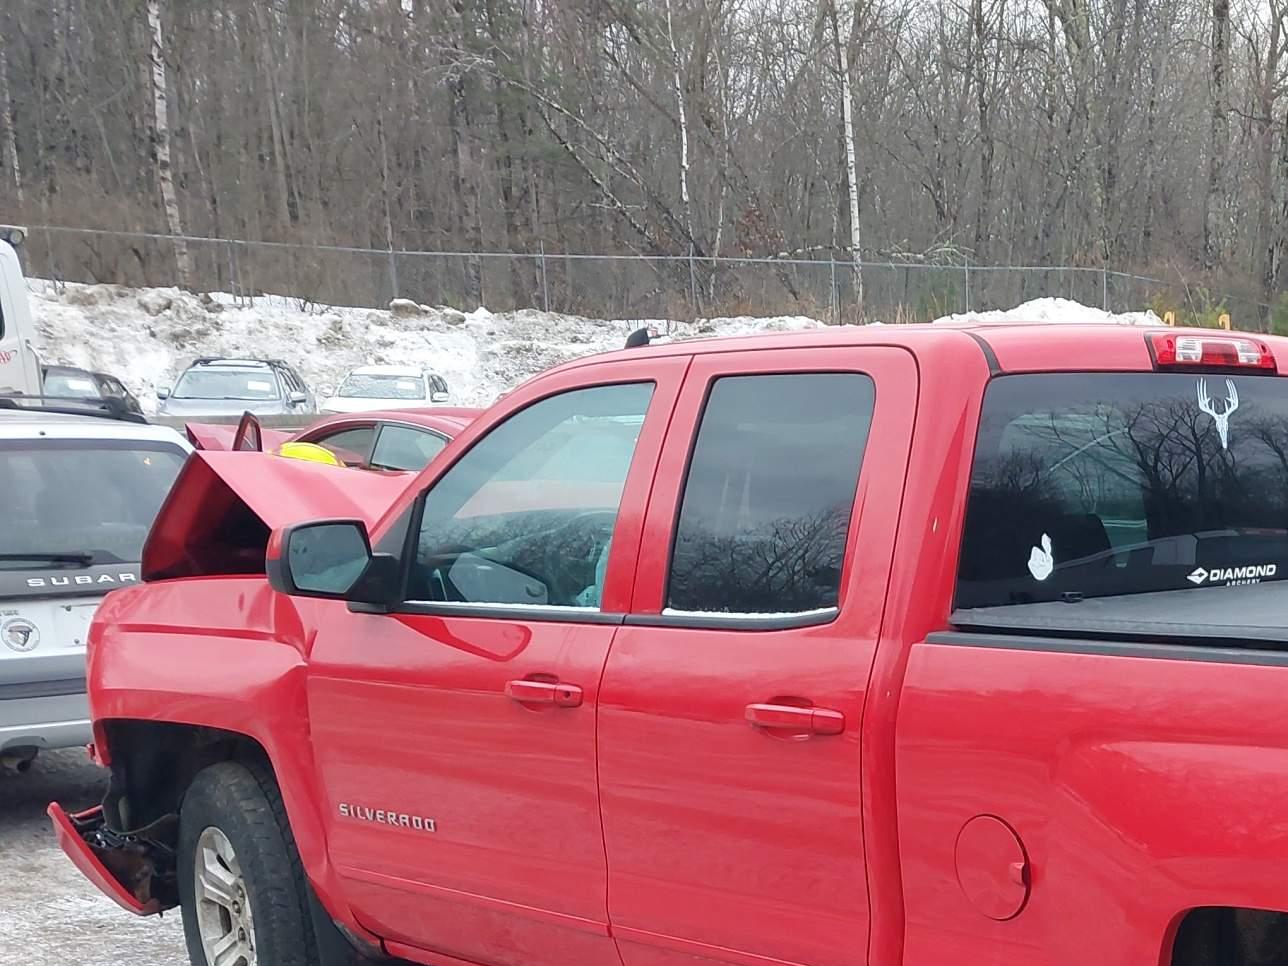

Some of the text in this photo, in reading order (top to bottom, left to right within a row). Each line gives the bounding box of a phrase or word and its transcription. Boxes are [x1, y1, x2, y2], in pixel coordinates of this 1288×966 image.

[26, 573, 137, 587] SUBAR
[1209, 564, 1277, 582] DIAMOND
[339, 803, 437, 832] SILVERADO
